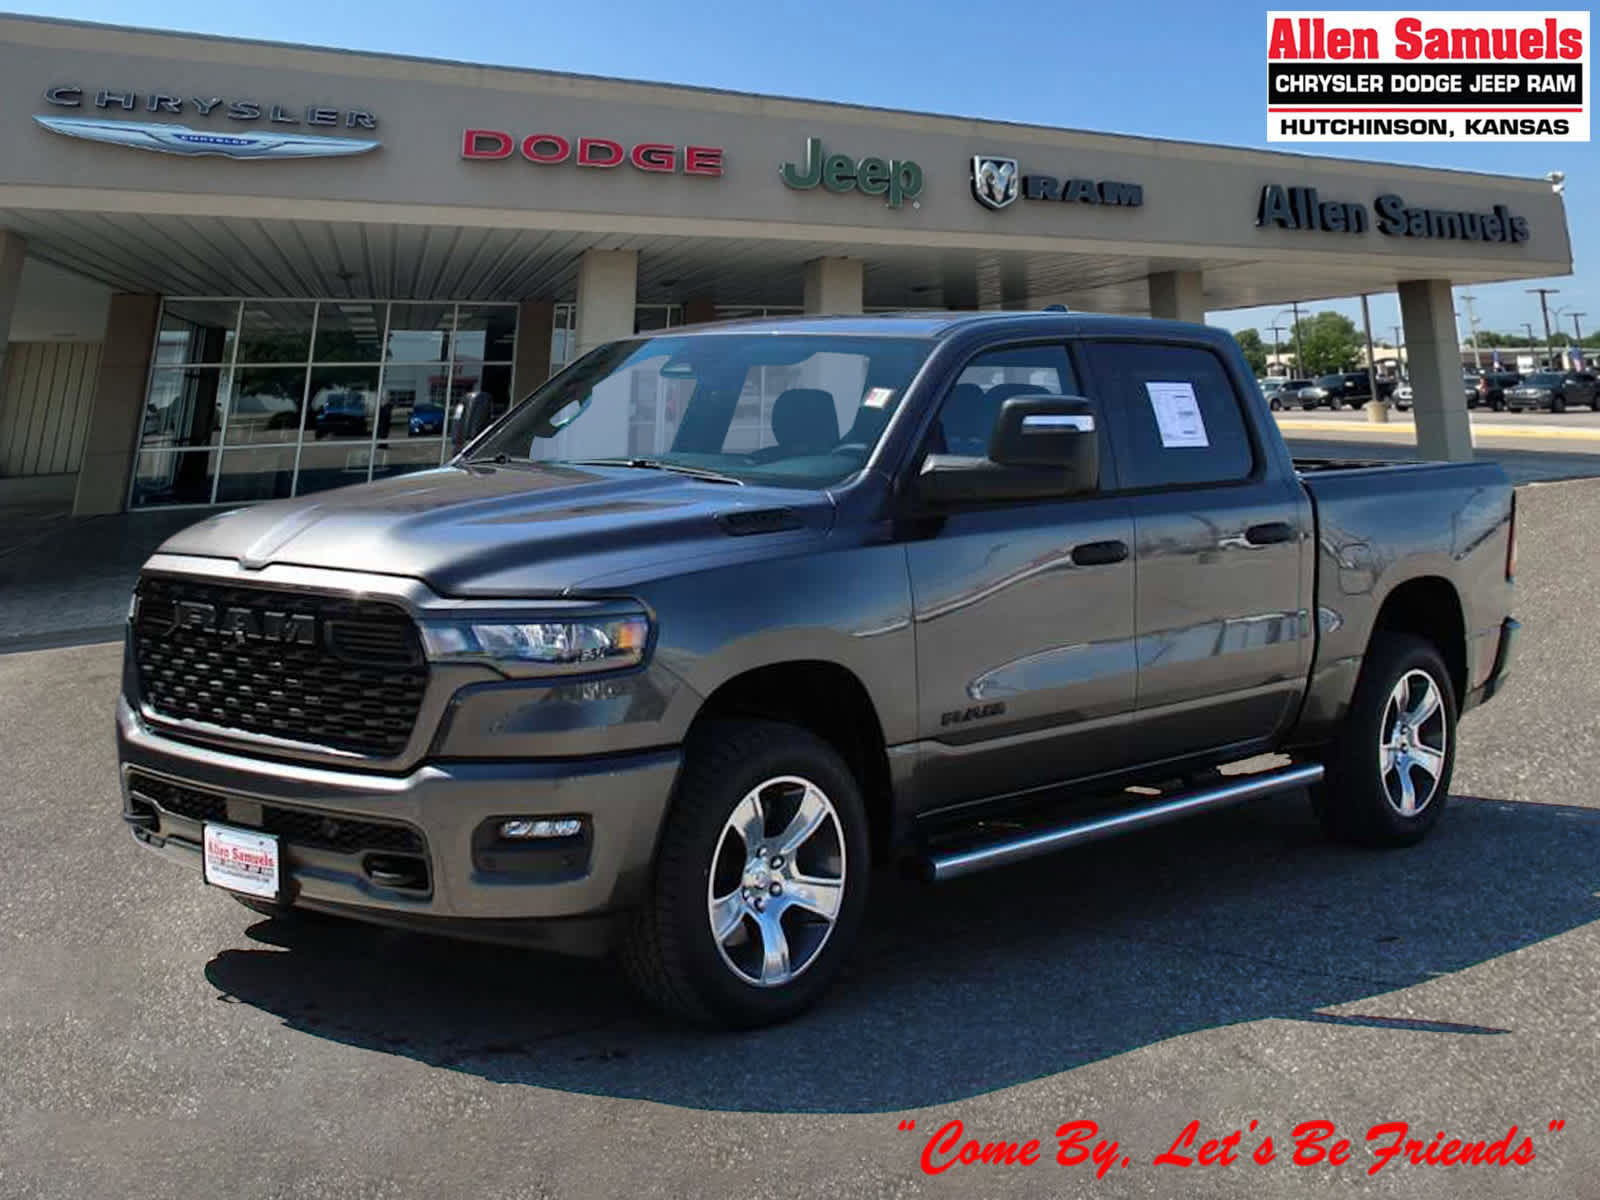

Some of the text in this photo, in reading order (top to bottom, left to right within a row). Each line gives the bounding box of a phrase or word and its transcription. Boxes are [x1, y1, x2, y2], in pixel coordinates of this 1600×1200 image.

[43, 86, 378, 130] CHRYSLER
[462, 128, 725, 176] DODGE
[780, 136, 924, 209] Jeep
[1022, 175, 1144, 207] RAM
[1256, 184, 1530, 243] Allen Samuels
